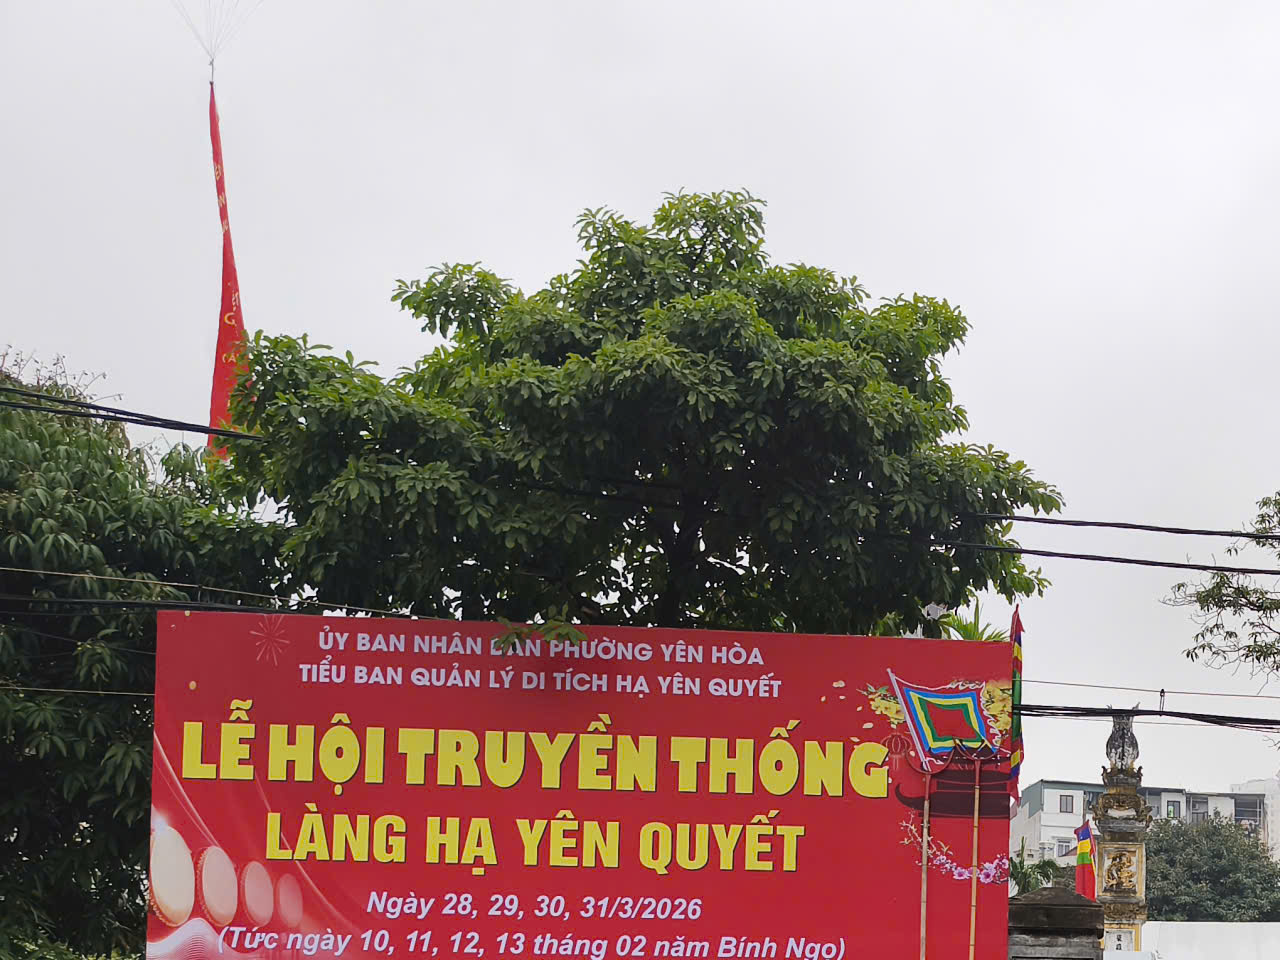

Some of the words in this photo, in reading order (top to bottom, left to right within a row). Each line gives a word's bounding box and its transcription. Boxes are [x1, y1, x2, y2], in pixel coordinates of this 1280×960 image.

[319, 625, 349, 650] ỦY
[357, 633, 405, 652] BAN
[414, 632, 482, 655] NHÂN
[549, 636, 653, 661] PHƯỜNG
[660, 640, 703, 663] YÊN
[711, 642, 765, 665] HÒA
[299, 655, 346, 683] TIỂU
[354, 665, 402, 685] BAN
[410, 663, 480, 687] QUẢN
[489, 666, 514, 689] LÝ
[522, 671, 545, 690] DI
[553, 668, 608, 692] TÍCH
[616, 674, 650, 699] HẠ
[658, 672, 701, 695] YÊN
[708, 672, 782, 698] QUYẾT
[182, 699, 256, 781] LỄ
[267, 713, 385, 796] HỘI
[398, 714, 657, 793] TRUYỀN
[670, 720, 890, 799] THỐNG
[266, 803, 407, 864] LÀNG
[425, 816, 498, 876] HẠ
[516, 810, 620, 869] YÊN
[639, 810, 805, 876] QUYẾT
[366, 891, 435, 920] Ngày
[442, 893, 478, 919] 28,
[488, 894, 525, 919] 29,
[534, 895, 570, 920] 30,
[580, 896, 702, 920] 31/3/2026
[217, 926, 278, 954] (Tức
[287, 930, 352, 956] ngày
[360, 929, 395, 955] 10,
[406, 930, 438, 956] 11,
[450, 931, 484, 957] 12,
[496, 932, 525, 953] 13
[616, 935, 645, 957] 02
[654, 935, 708, 958] năm
[717, 936, 777, 959] Bính
